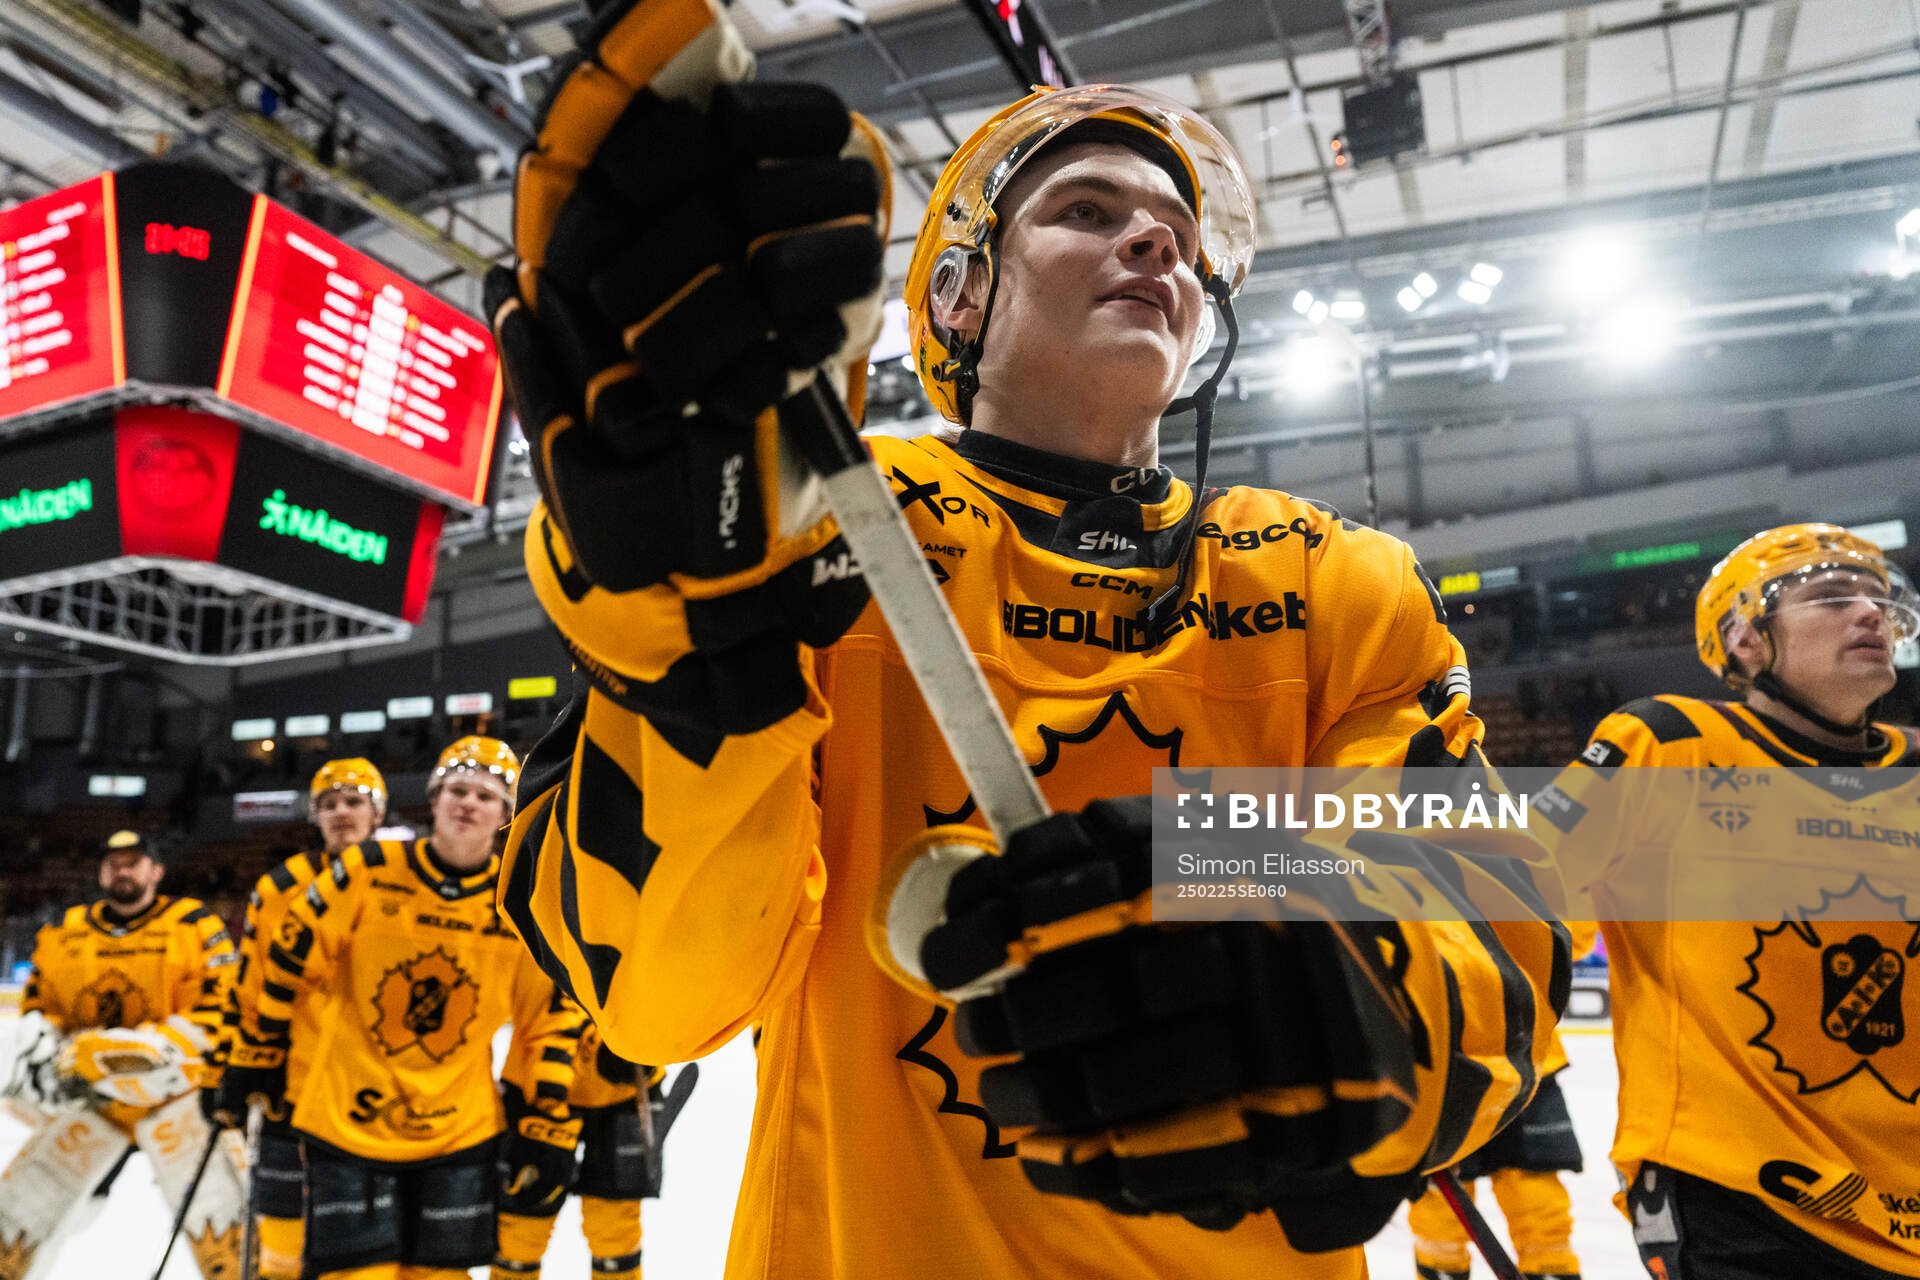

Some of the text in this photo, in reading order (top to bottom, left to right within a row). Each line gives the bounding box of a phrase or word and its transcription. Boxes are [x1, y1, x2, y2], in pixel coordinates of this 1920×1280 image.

[884, 464, 991, 528] XOR
[917, 542, 967, 559] AMET
[1071, 572, 1154, 600] CCM
[1806, 818, 1920, 849] BOLIDEN
